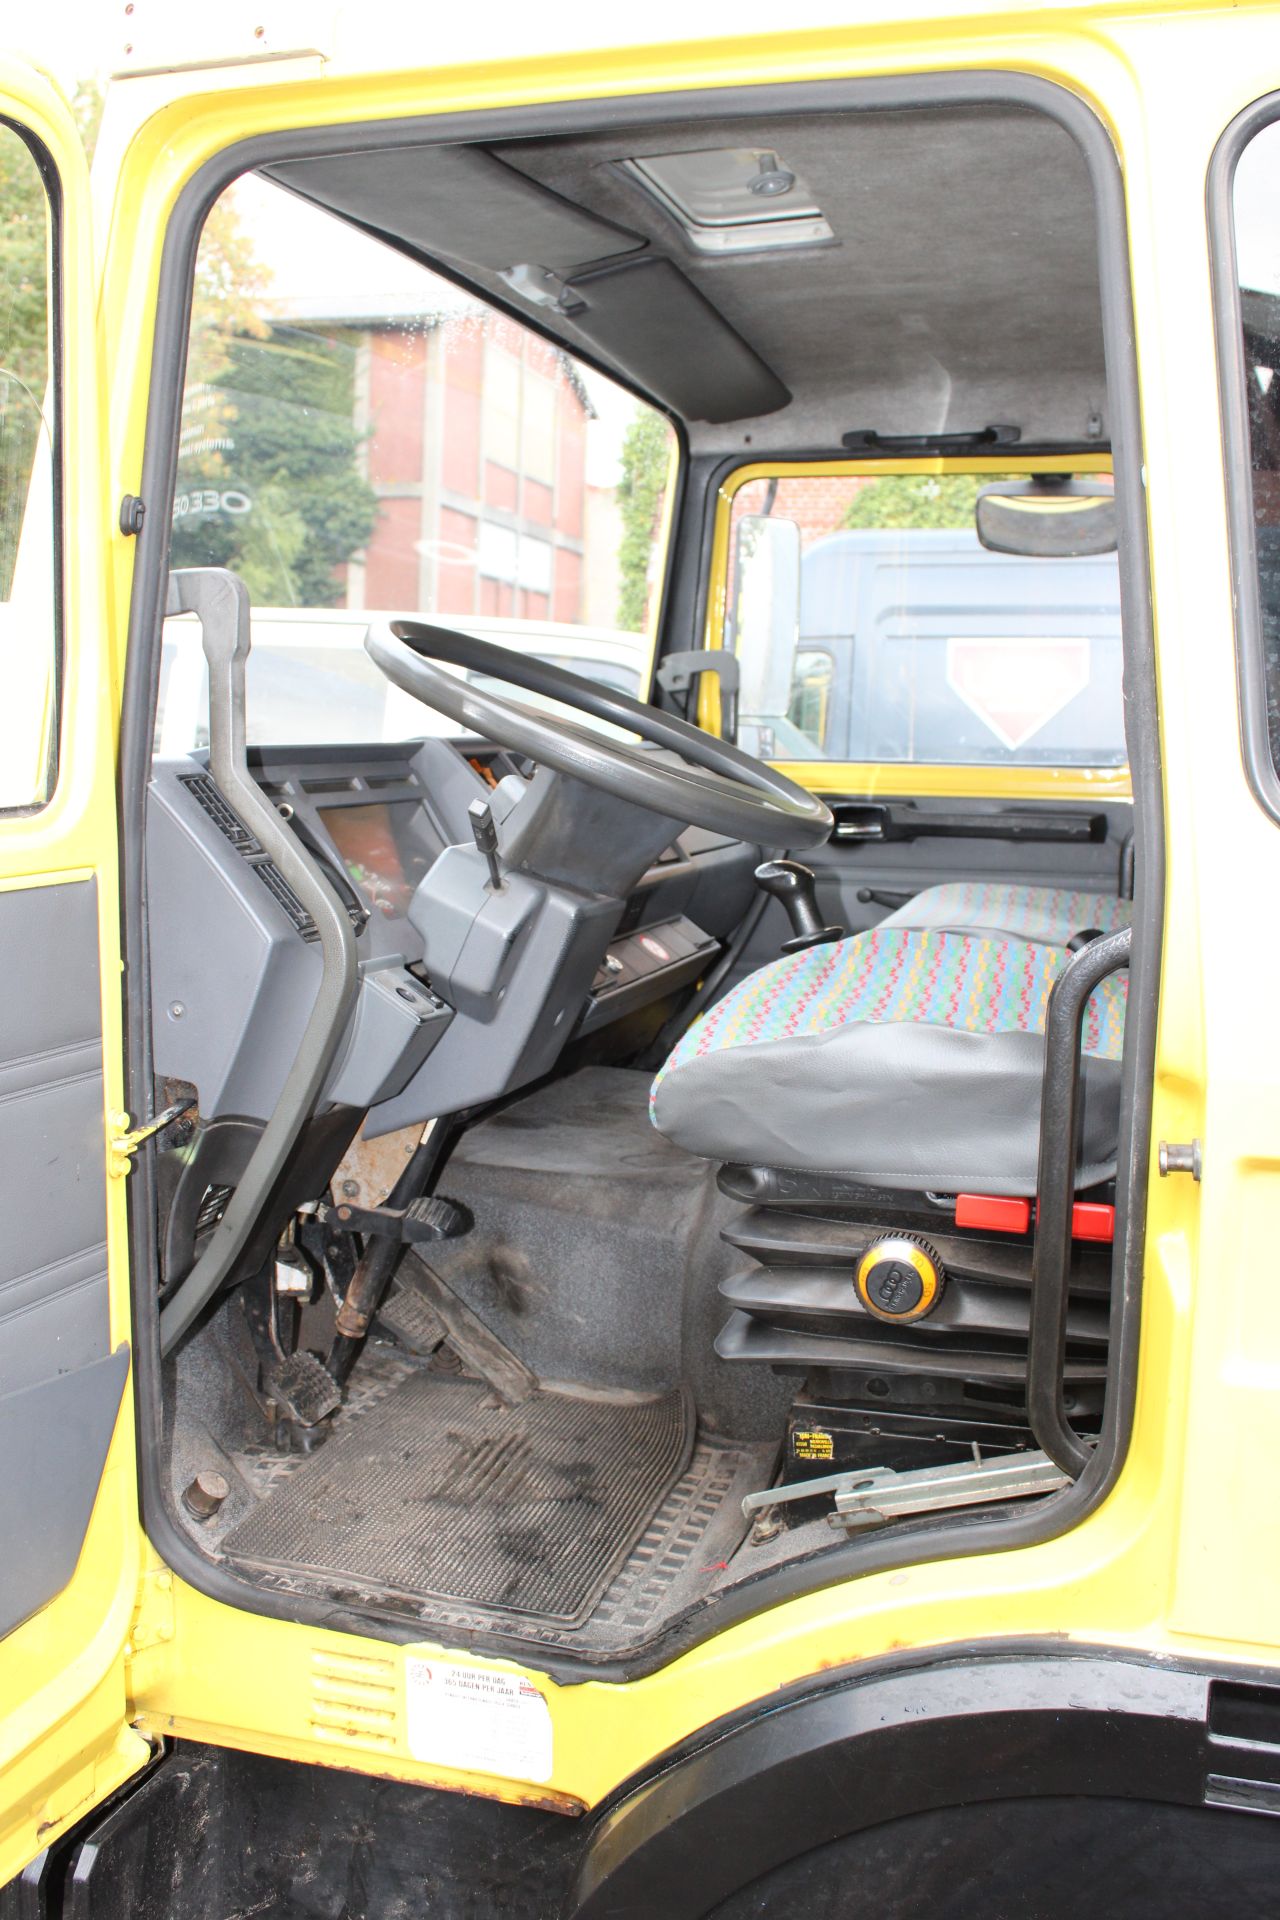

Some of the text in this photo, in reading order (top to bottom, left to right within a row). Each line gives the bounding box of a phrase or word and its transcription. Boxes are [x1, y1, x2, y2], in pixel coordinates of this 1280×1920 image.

[478, 1673, 490, 1683] PER
[493, 1676, 506, 1685] DAG
[458, 1680, 480, 1691] DAGEN
[482, 1684, 495, 1693] PER
[496, 1686, 514, 1696] JAAR
